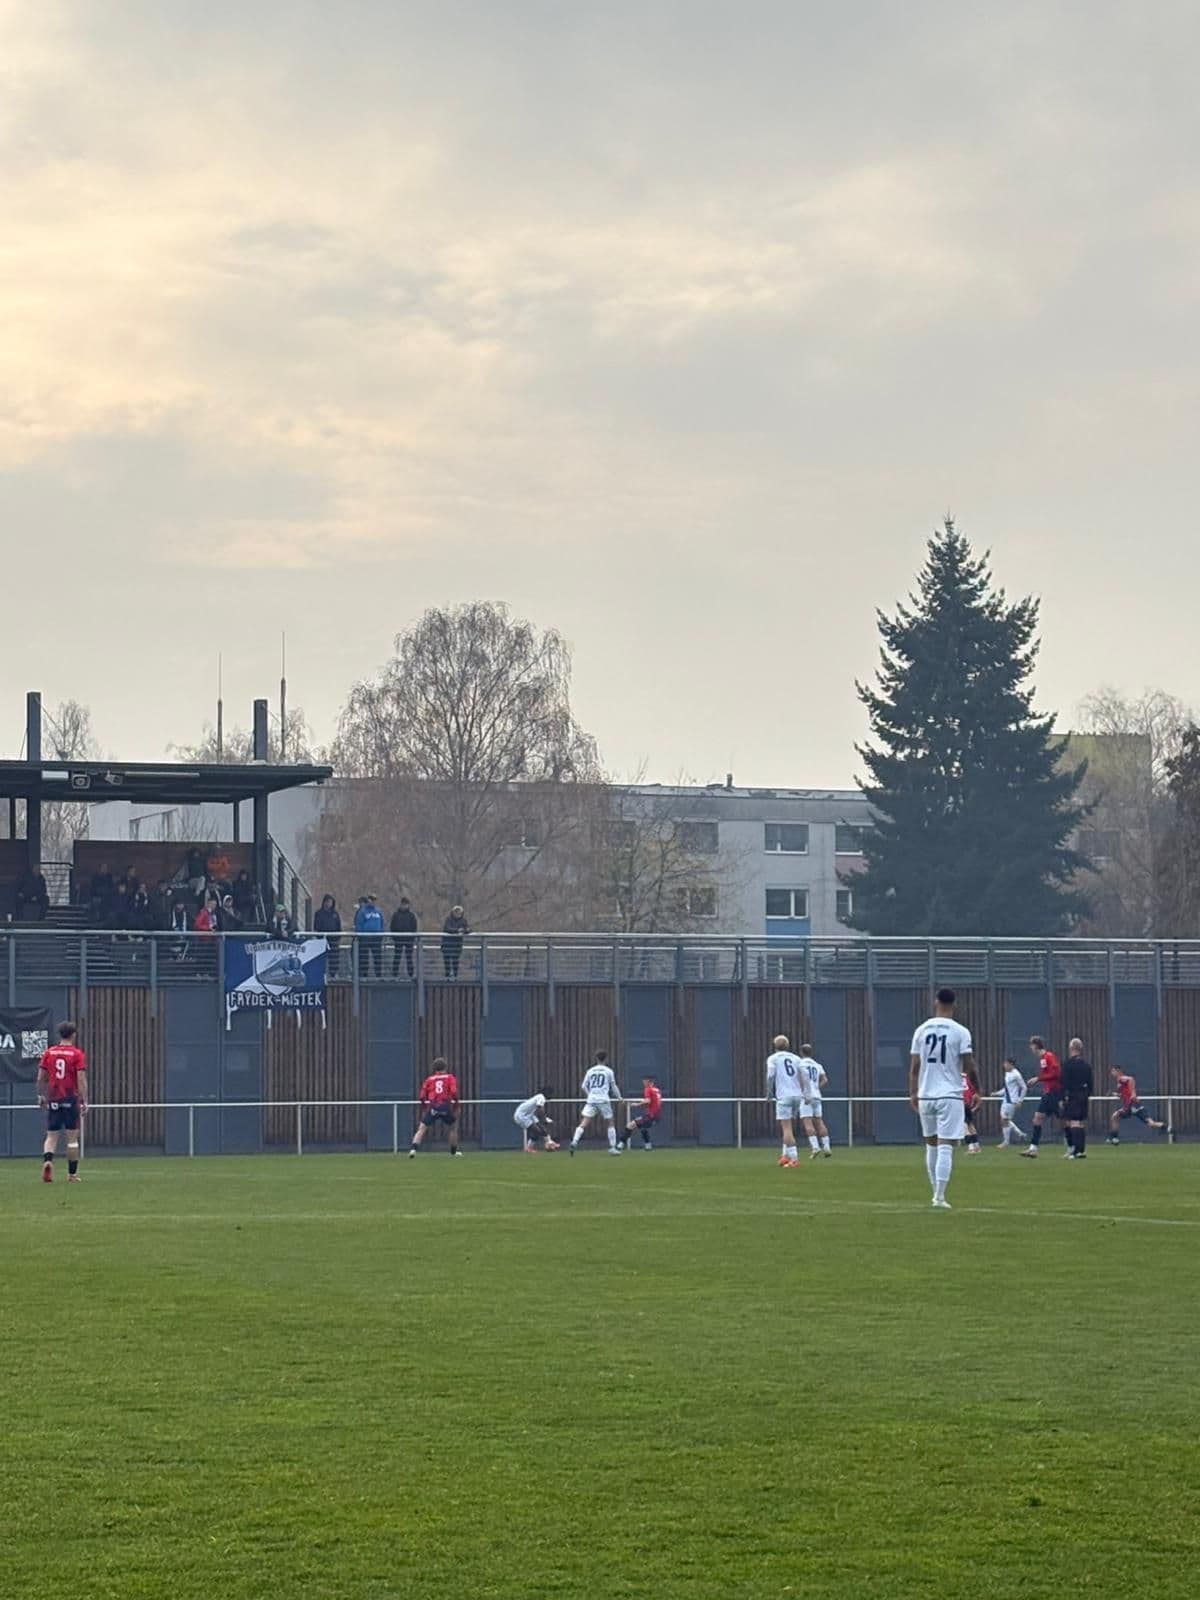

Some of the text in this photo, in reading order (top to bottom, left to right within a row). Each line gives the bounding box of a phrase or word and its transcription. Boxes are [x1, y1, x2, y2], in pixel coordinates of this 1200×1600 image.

[925, 1033, 947, 1064] 21
[56, 1058, 66, 1079] 9
[784, 1058, 795, 1077] 6
[806, 1065, 818, 1082] 10
[435, 1080, 444, 1094] 8
[590, 1073, 605, 1088] 20
